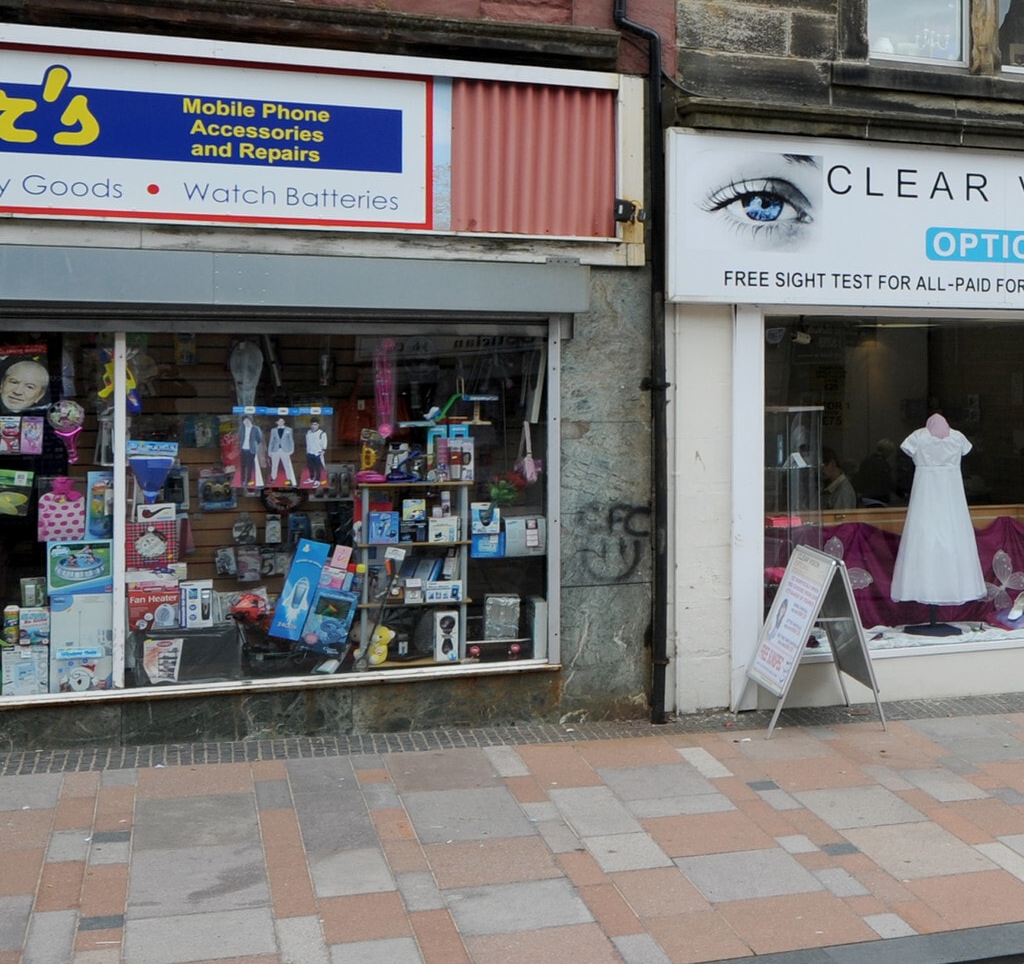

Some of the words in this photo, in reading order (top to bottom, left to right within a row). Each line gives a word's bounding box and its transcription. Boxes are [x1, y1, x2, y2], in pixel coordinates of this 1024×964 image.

[182, 97, 255, 118] Mobile
[262, 102, 330, 123] Phone
[190, 119, 324, 142] Accessories
[191, 141, 232, 158] and
[239, 143, 320, 163] Repairs
[22, 174, 123, 199] Goods
[826, 164, 989, 203] CLEAR
[183, 182, 276, 205] Watch
[286, 186, 399, 210] Batteries
[724, 270, 769, 287] FREE
[775, 271, 826, 289] SIGHT
[831, 273, 874, 290] TEST
[878, 274, 911, 291] FOR
[916, 275, 991, 293] ALL-PAID
[129, 596, 146, 604] Fan
[148, 594, 178, 603] Heater
